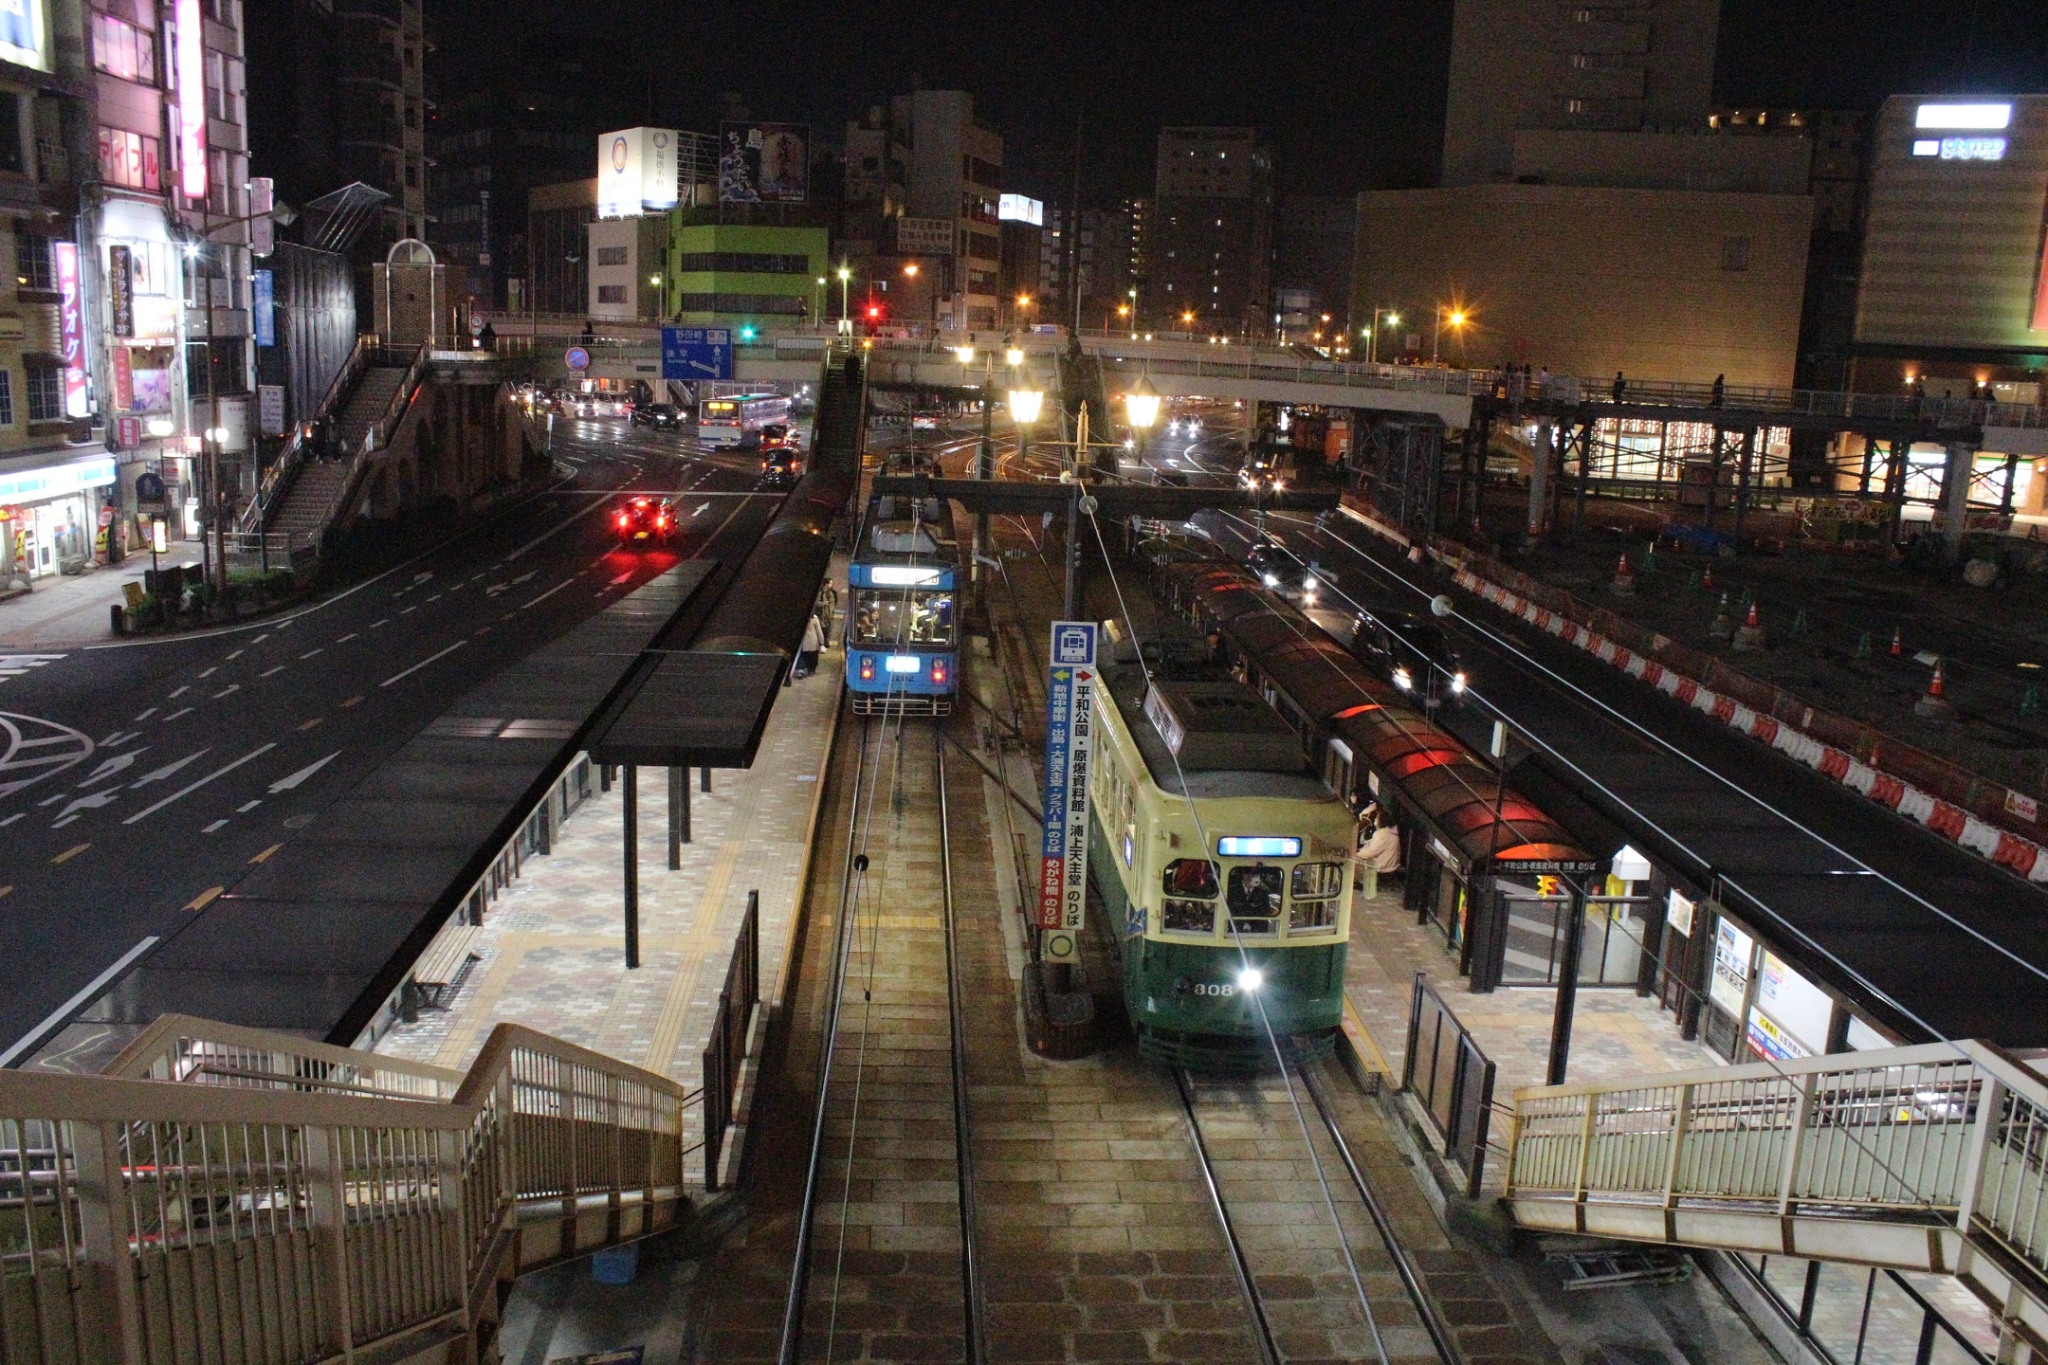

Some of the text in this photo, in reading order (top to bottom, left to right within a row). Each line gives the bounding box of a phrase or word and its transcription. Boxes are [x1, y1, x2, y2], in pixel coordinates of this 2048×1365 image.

[746, 128, 765, 149] 島
[1941, 139, 2005, 150] UNITED
[100, 141, 157, 175] アイフル
[1047, 685, 1067, 853] 新地中華街・出島・大浦天主堂・グラバー園 のりば
[1067, 685, 1091, 926] 平和公園・原爆資料館・浦上天主堂 のりば
[1578, 862, 1596, 870] のりば
[1044, 859, 1060, 925] めがね橋 のりば
